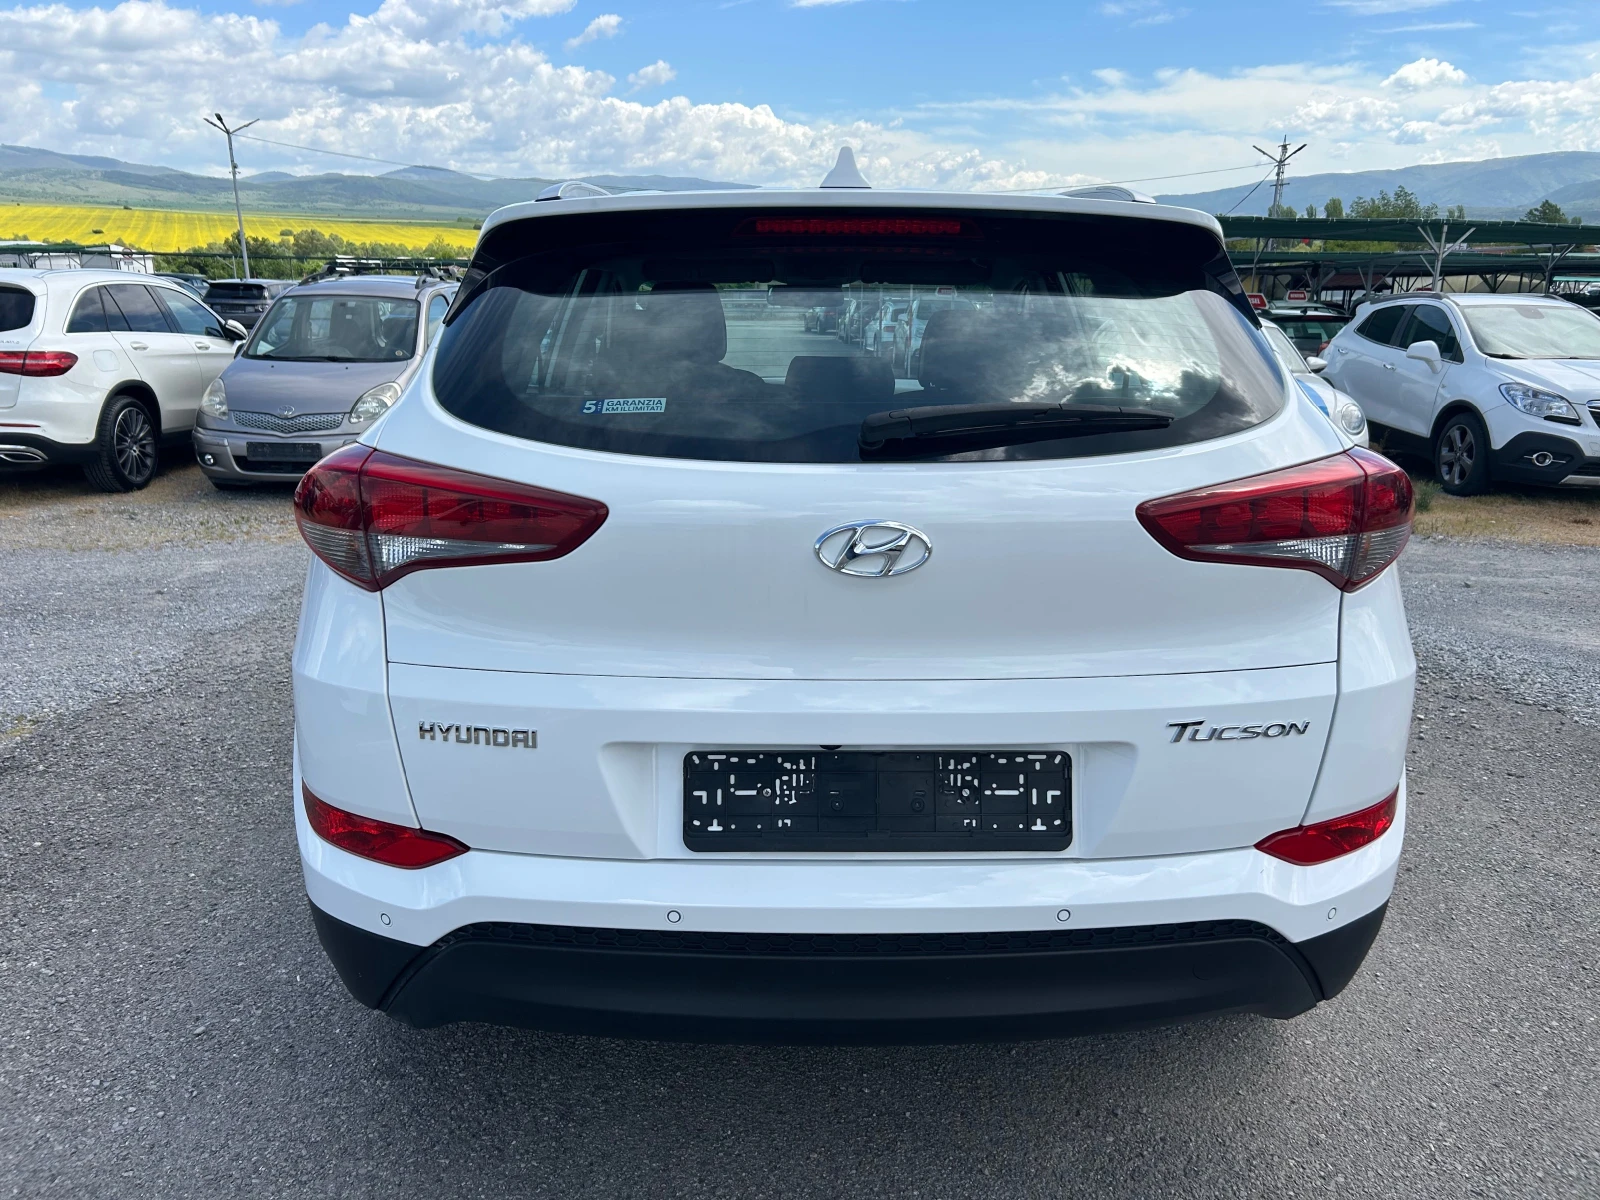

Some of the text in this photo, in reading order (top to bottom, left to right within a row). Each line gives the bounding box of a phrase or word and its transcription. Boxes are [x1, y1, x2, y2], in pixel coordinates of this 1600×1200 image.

[583, 400, 597, 413] 5
[418, 720, 538, 749] HYUNDAI
[1166, 718, 1311, 743] TUCSON
